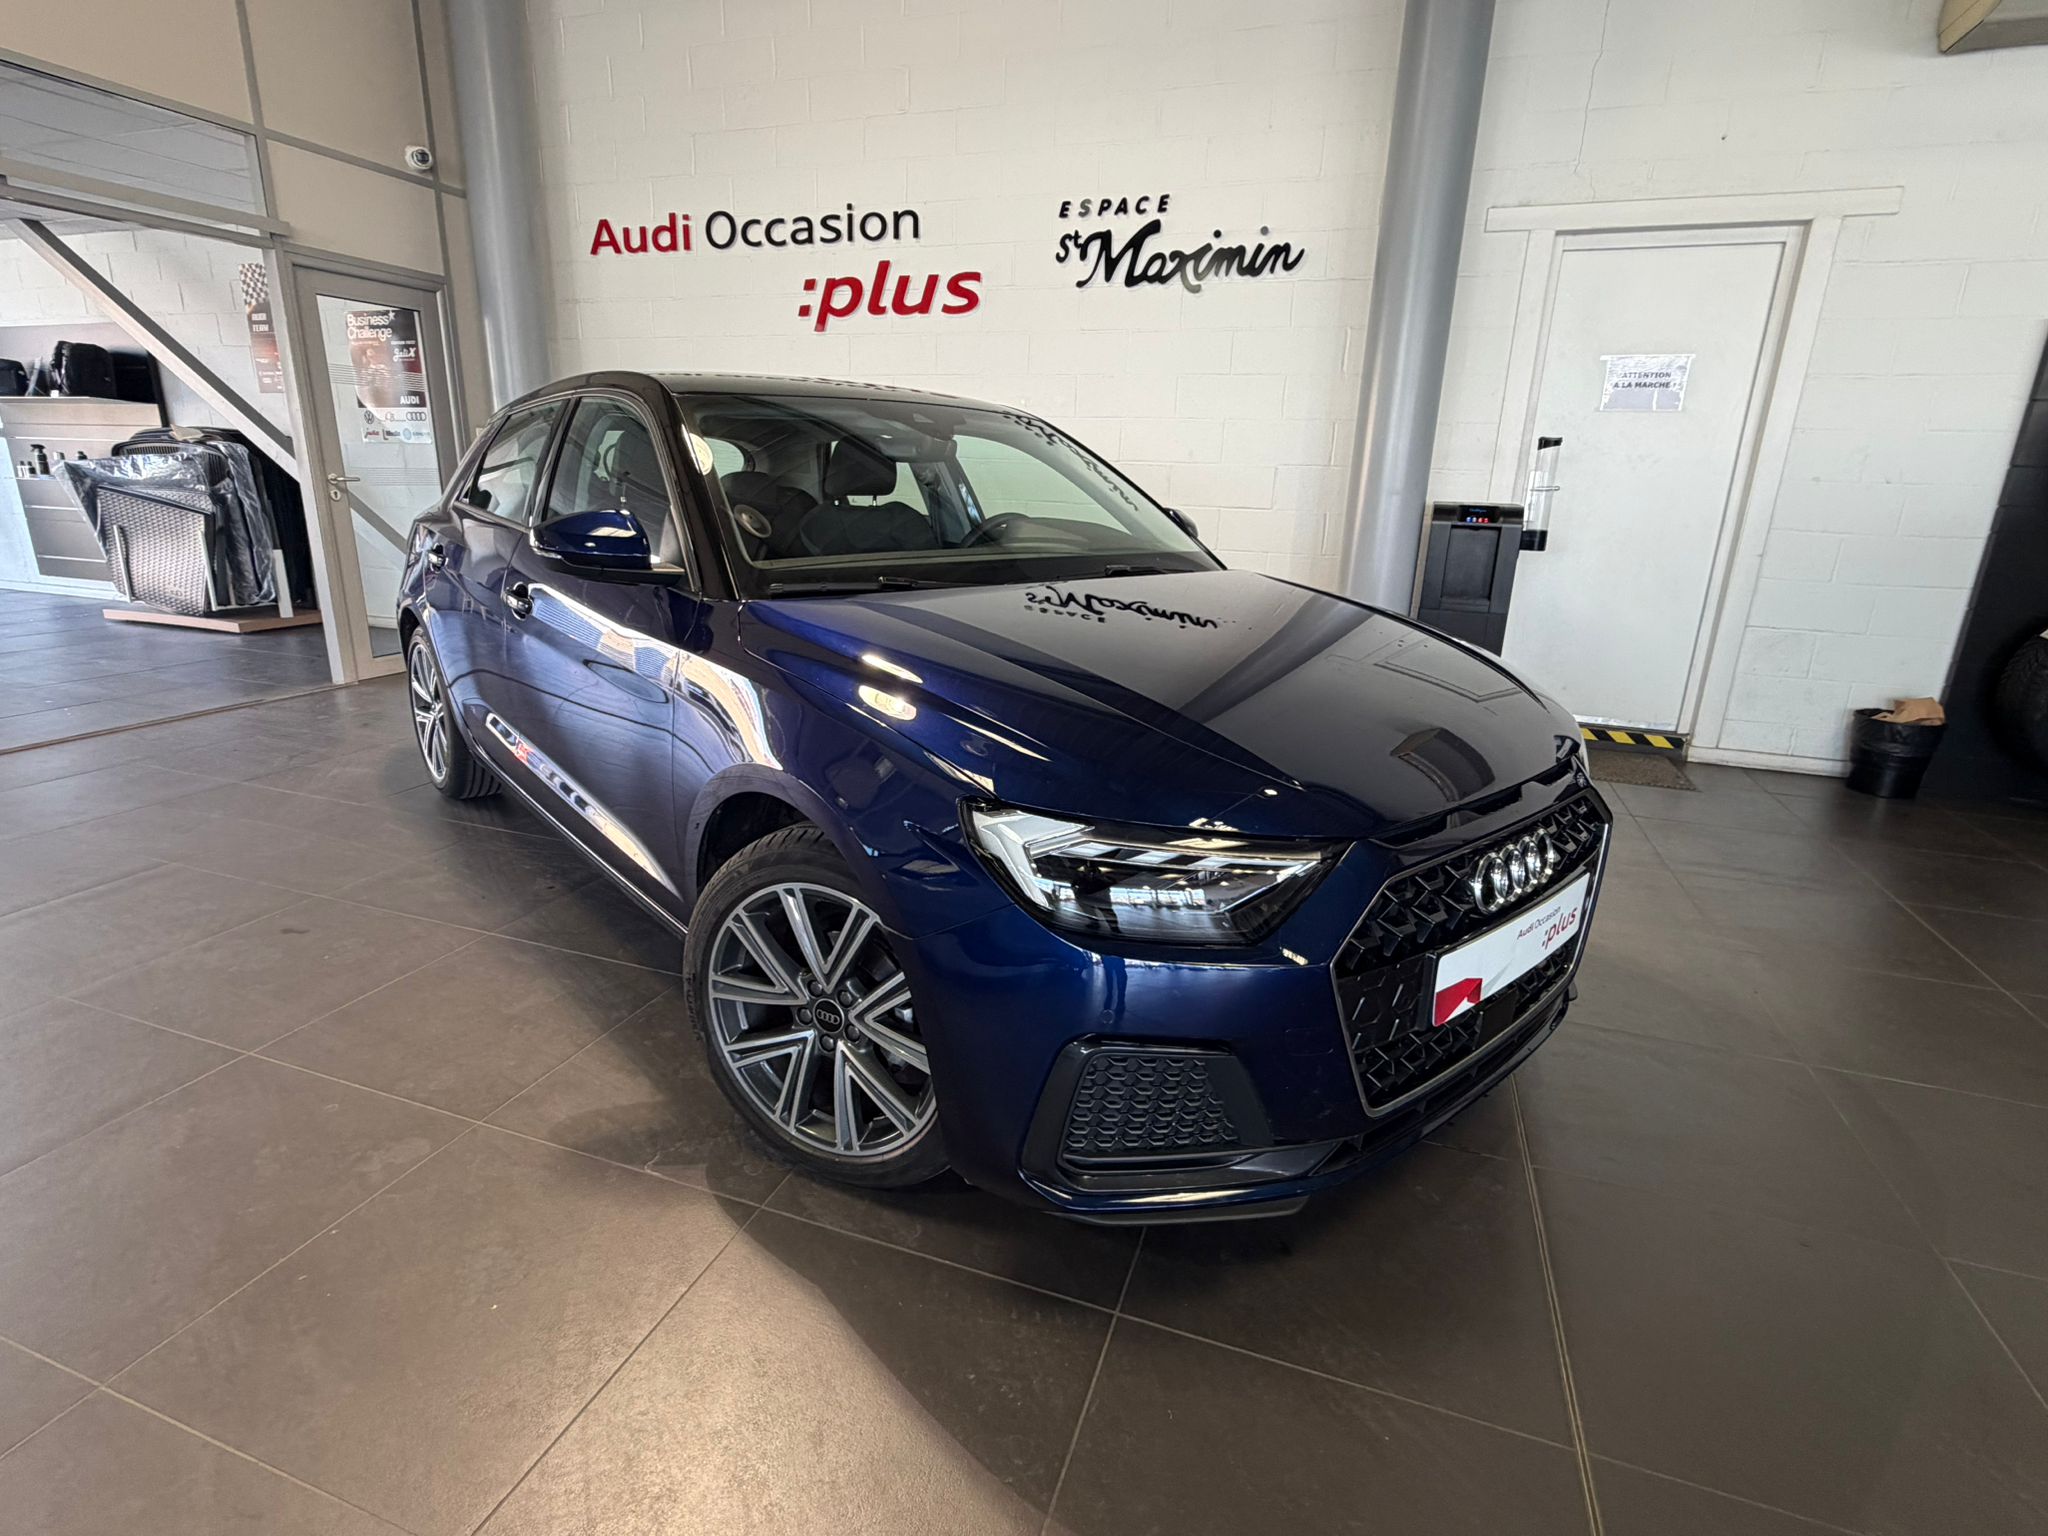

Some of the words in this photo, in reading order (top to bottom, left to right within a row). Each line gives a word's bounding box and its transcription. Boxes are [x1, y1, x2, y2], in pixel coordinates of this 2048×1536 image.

[1058, 193, 1170, 219] ESPACE
[591, 213, 692, 256] Audi
[705, 203, 919, 250] Occasion
[1075, 219, 1305, 293] Maximin
[799, 260, 983, 333] :plus
[346, 312, 390, 327] Business
[347, 326, 393, 341] Challenge
[400, 395, 420, 405] AUDI
[1517, 922, 1534, 940] Audi
[1534, 906, 1561, 929] Occasion
[1541, 907, 1578, 950] :plus
